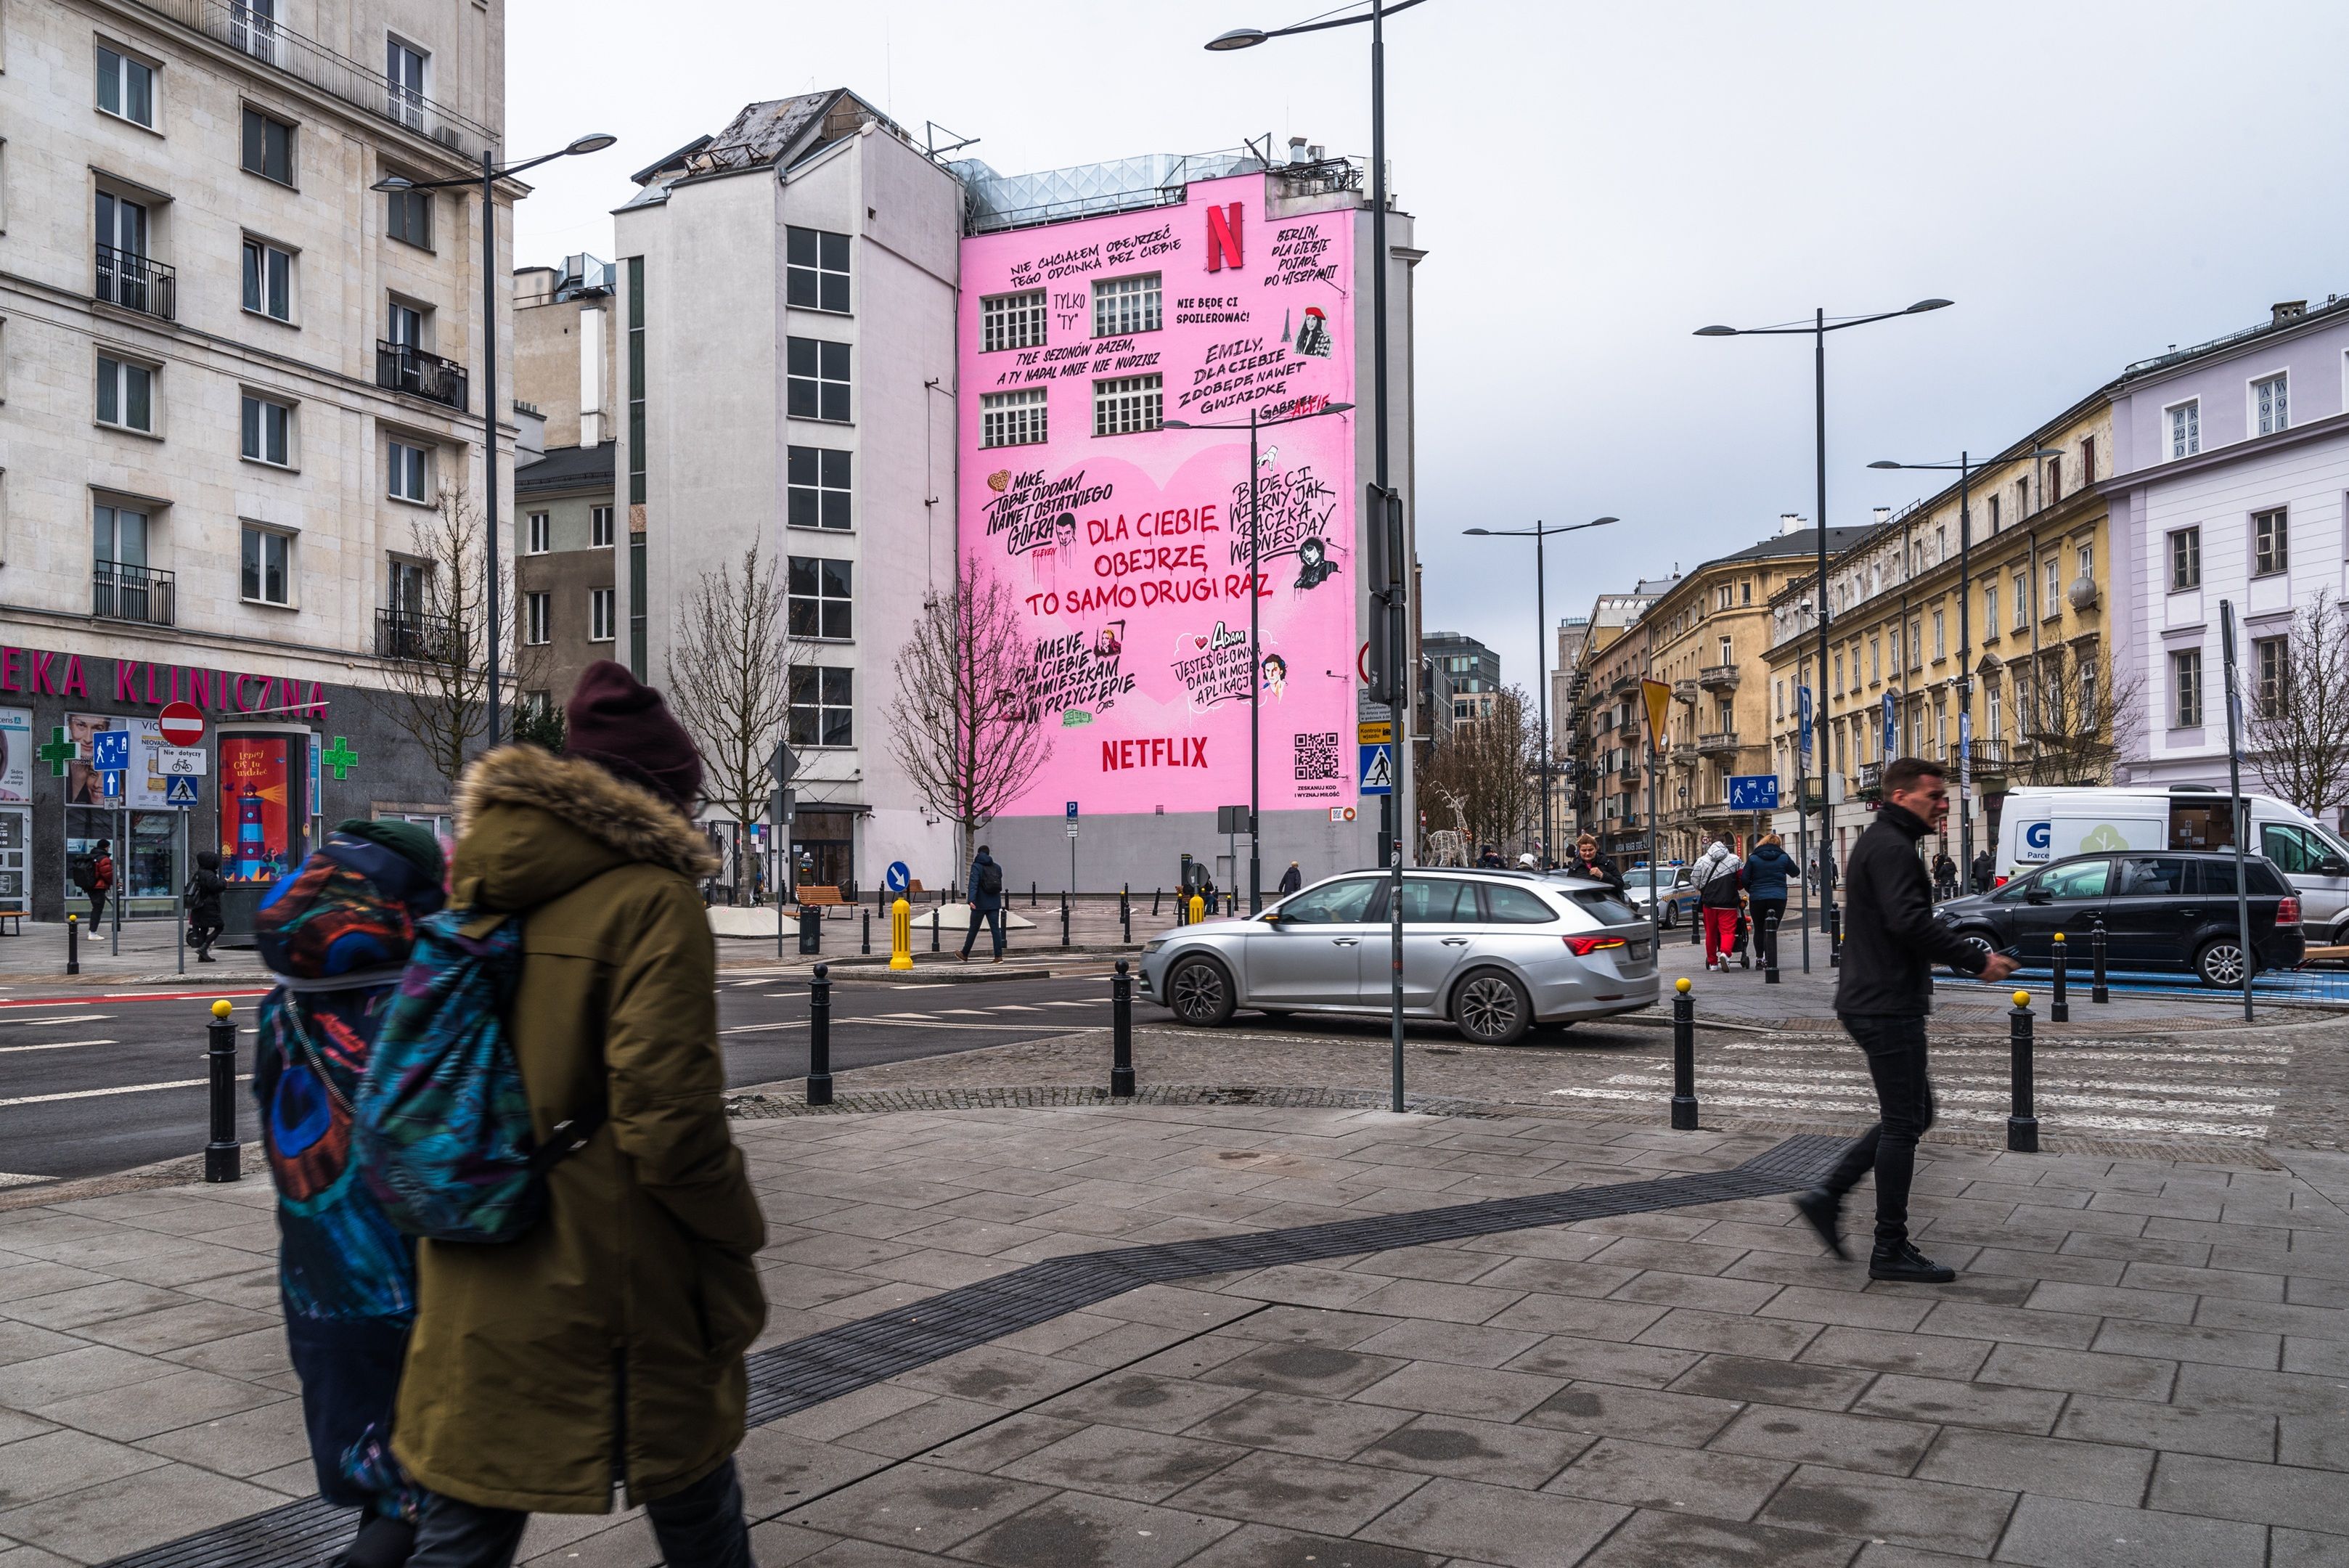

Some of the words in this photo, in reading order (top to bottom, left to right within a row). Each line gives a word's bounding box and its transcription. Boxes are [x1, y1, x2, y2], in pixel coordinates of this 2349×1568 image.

[1207, 201, 1243, 273] N
[1272, 243, 1294, 257] DLA
[1294, 239, 1331, 255] CIEBIE
[1277, 224, 1319, 242] BERLIN,
[1010, 261, 1031, 275] NIE
[1038, 244, 1099, 269] CHCIAŁEM
[1106, 224, 1172, 252] OBEJRZEĆ
[1010, 272, 1041, 287] TEGO
[1048, 257, 1102, 280] ODCINKA
[1108, 250, 1135, 266] BEZ
[1140, 239, 1182, 258] CIEBIE
[1265, 274, 1279, 287] DO
[1053, 292, 1086, 310] TYLKO
[1176, 310, 1250, 324] SPOILEROWAĆ!
[1177, 298, 1195, 309] NIE
[1198, 297, 1222, 311] BĘDĘ
[1226, 297, 1238, 307] CI
[1016, 351, 1040, 366] TYLE
[1043, 341, 1092, 362] SEZONÓW
[1095, 338, 1135, 355] RAZEM,
[1193, 363, 1226, 385] DLA
[1228, 348, 1286, 373] CIEBIE
[1205, 337, 1263, 364] EMILY,
[997, 372, 1007, 385] A
[1008, 370, 1022, 385] TY
[1024, 366, 1057, 383] NADAL
[1060, 362, 1090, 377] MNIE
[1092, 358, 1112, 373] NIE
[1115, 352, 1161, 370] NUDZISZ
[1256, 362, 1307, 384] NAWET
[982, 489, 1031, 515] TOBIE
[1032, 470, 1085, 502] ODDAM
[1012, 470, 1045, 492] MIKE,
[1233, 474, 1282, 505] BDĘ
[1284, 466, 1314, 488] CI
[1293, 480, 1336, 506] JAK
[986, 503, 1034, 536] NAWET
[1034, 483, 1113, 520] OSTATNIEGO
[1087, 513, 1129, 545] DLA
[1137, 505, 1220, 538] CIEBIE
[1008, 514, 1055, 555] GOFRA
[1031, 547, 1058, 558] ELEVEN
[1094, 544, 1208, 577] OBEJRZĘ
[1026, 592, 1059, 616] TO
[1066, 583, 1137, 613] SAMO
[1140, 578, 1219, 606] DRUGI
[1225, 573, 1273, 599] RAZ
[1034, 631, 1085, 663] MAEVE,
[1015, 665, 1039, 688] DLA
[1042, 649, 1092, 679] CIEBIE
[1025, 656, 1120, 704] ZAMIESZKAM
[1186, 669, 1217, 690] DANĄ
[1219, 667, 1227, 680] W
[1230, 659, 1259, 678] MOJE
[116, 658, 327, 719] KLINICZNA
[1027, 701, 1041, 724] W
[1045, 672, 1136, 717] PRZYCZEPIE
[142, 721, 160, 731] VIC
[1803, 692, 1810, 732] P
[1886, 700, 1892, 732] P
[141, 739, 174, 748] NEOVADIO
[179, 749, 201, 758] dotyczy
[239, 750, 264, 760] Lepiej
[1102, 736, 1209, 772] NETFLIX
[1069, 803, 1076, 813] P
